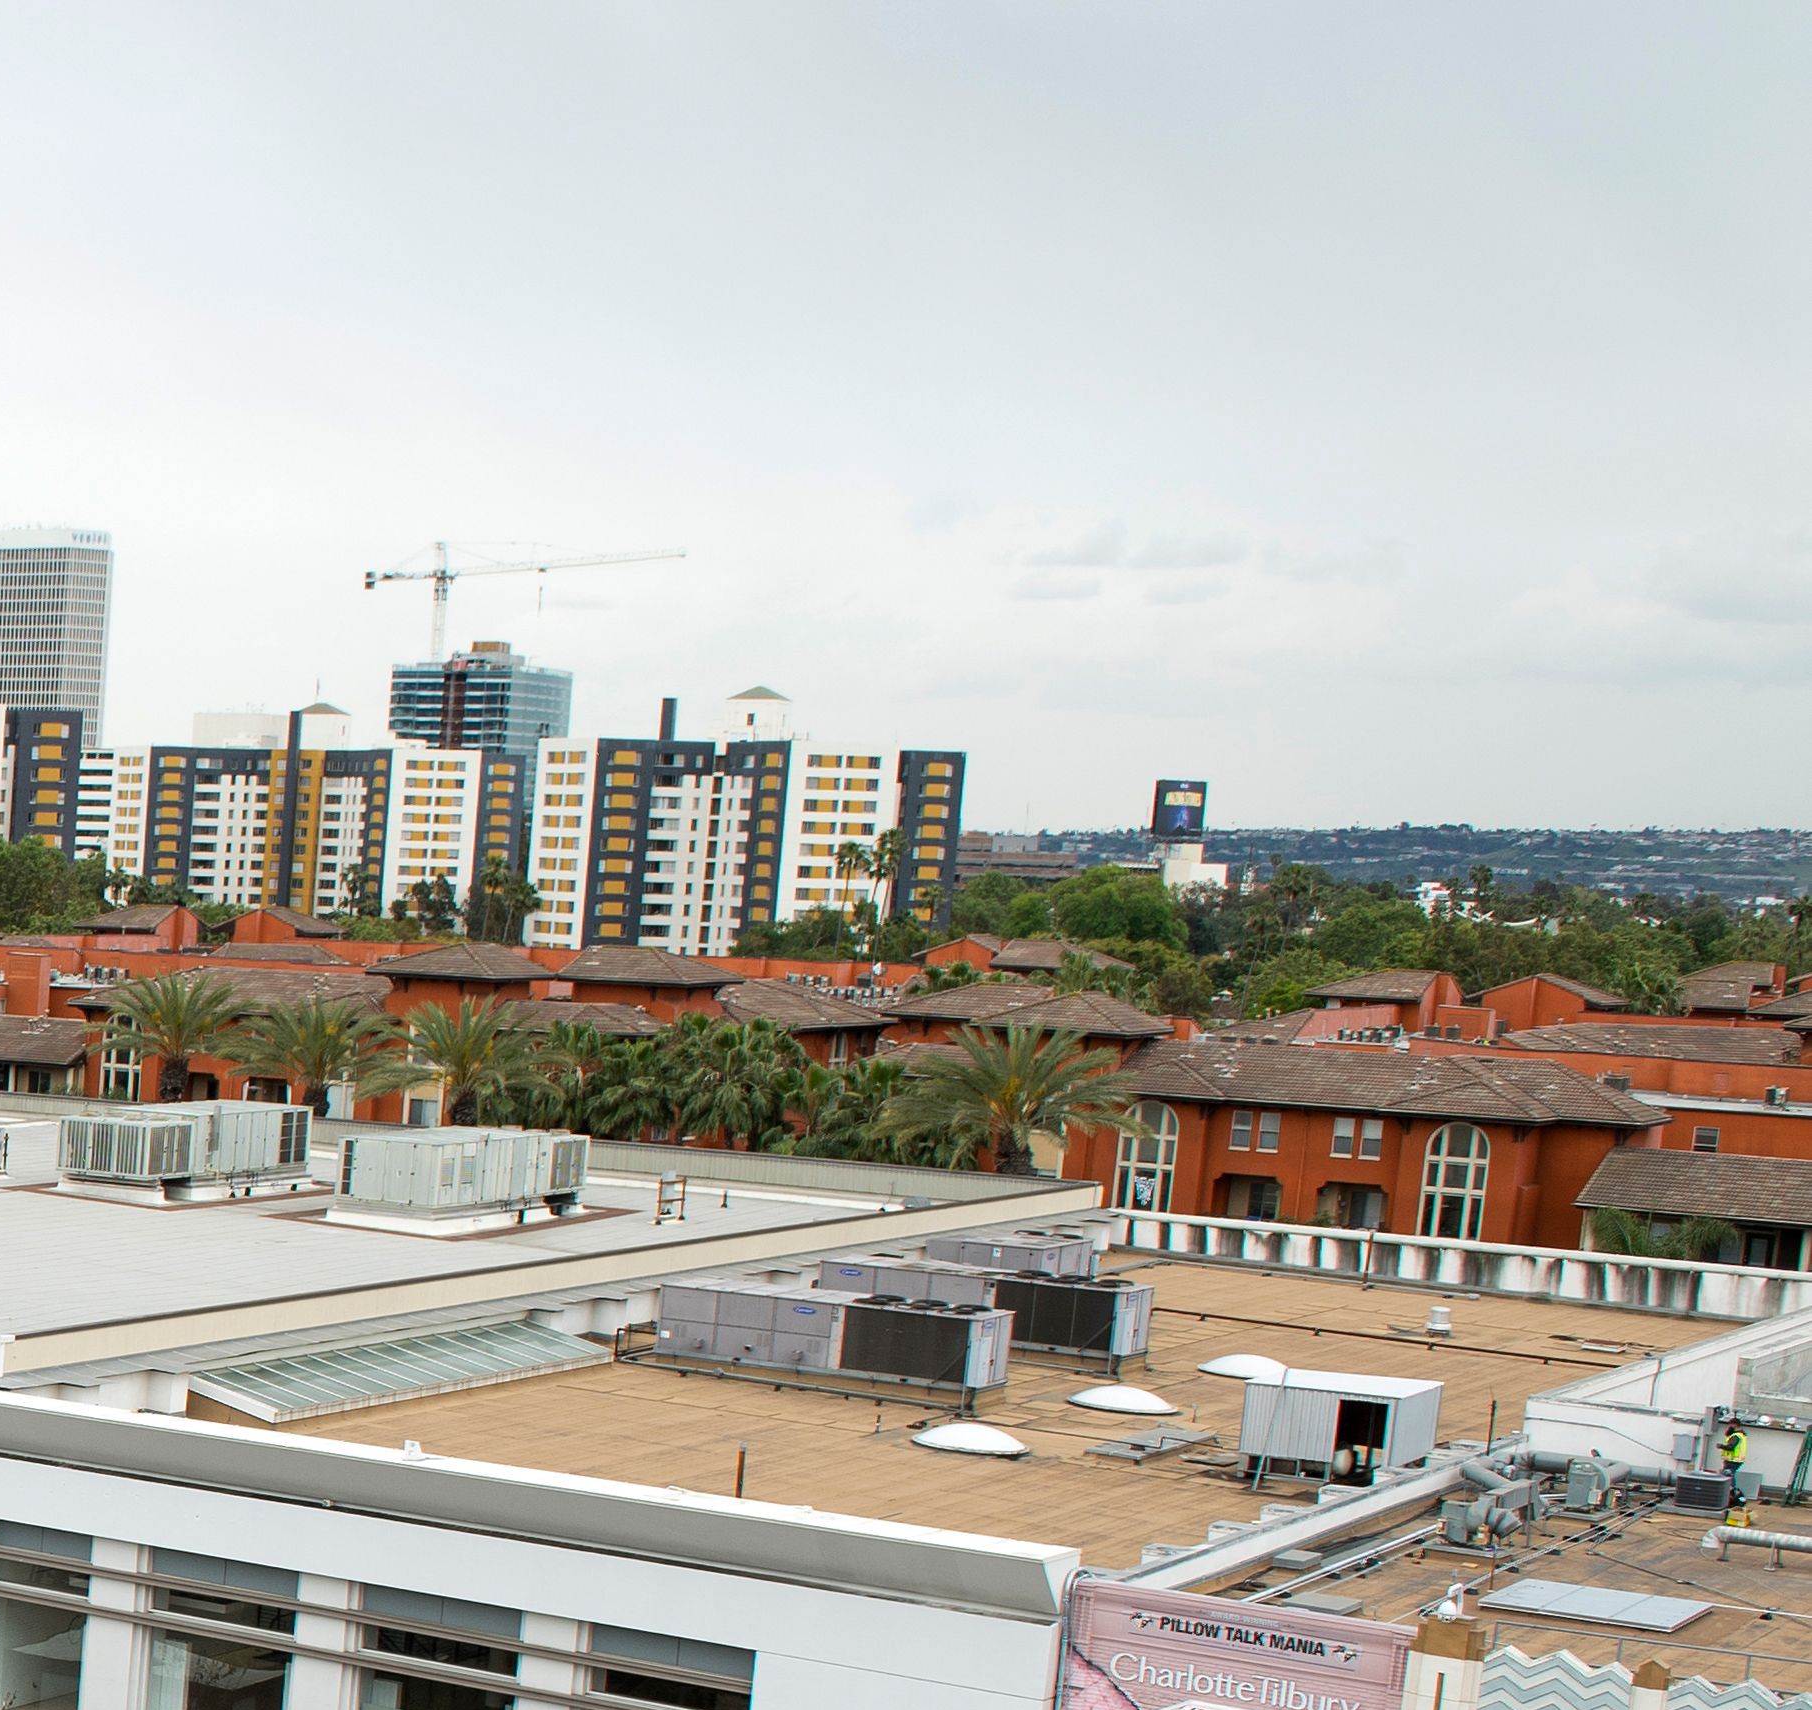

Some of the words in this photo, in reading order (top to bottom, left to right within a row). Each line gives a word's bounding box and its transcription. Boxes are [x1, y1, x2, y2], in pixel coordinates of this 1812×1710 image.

[1160, 1616, 1220, 1639] PILLOW
[1225, 1626, 1265, 1647] TALK
[1269, 1633, 1326, 1657] MANIA
